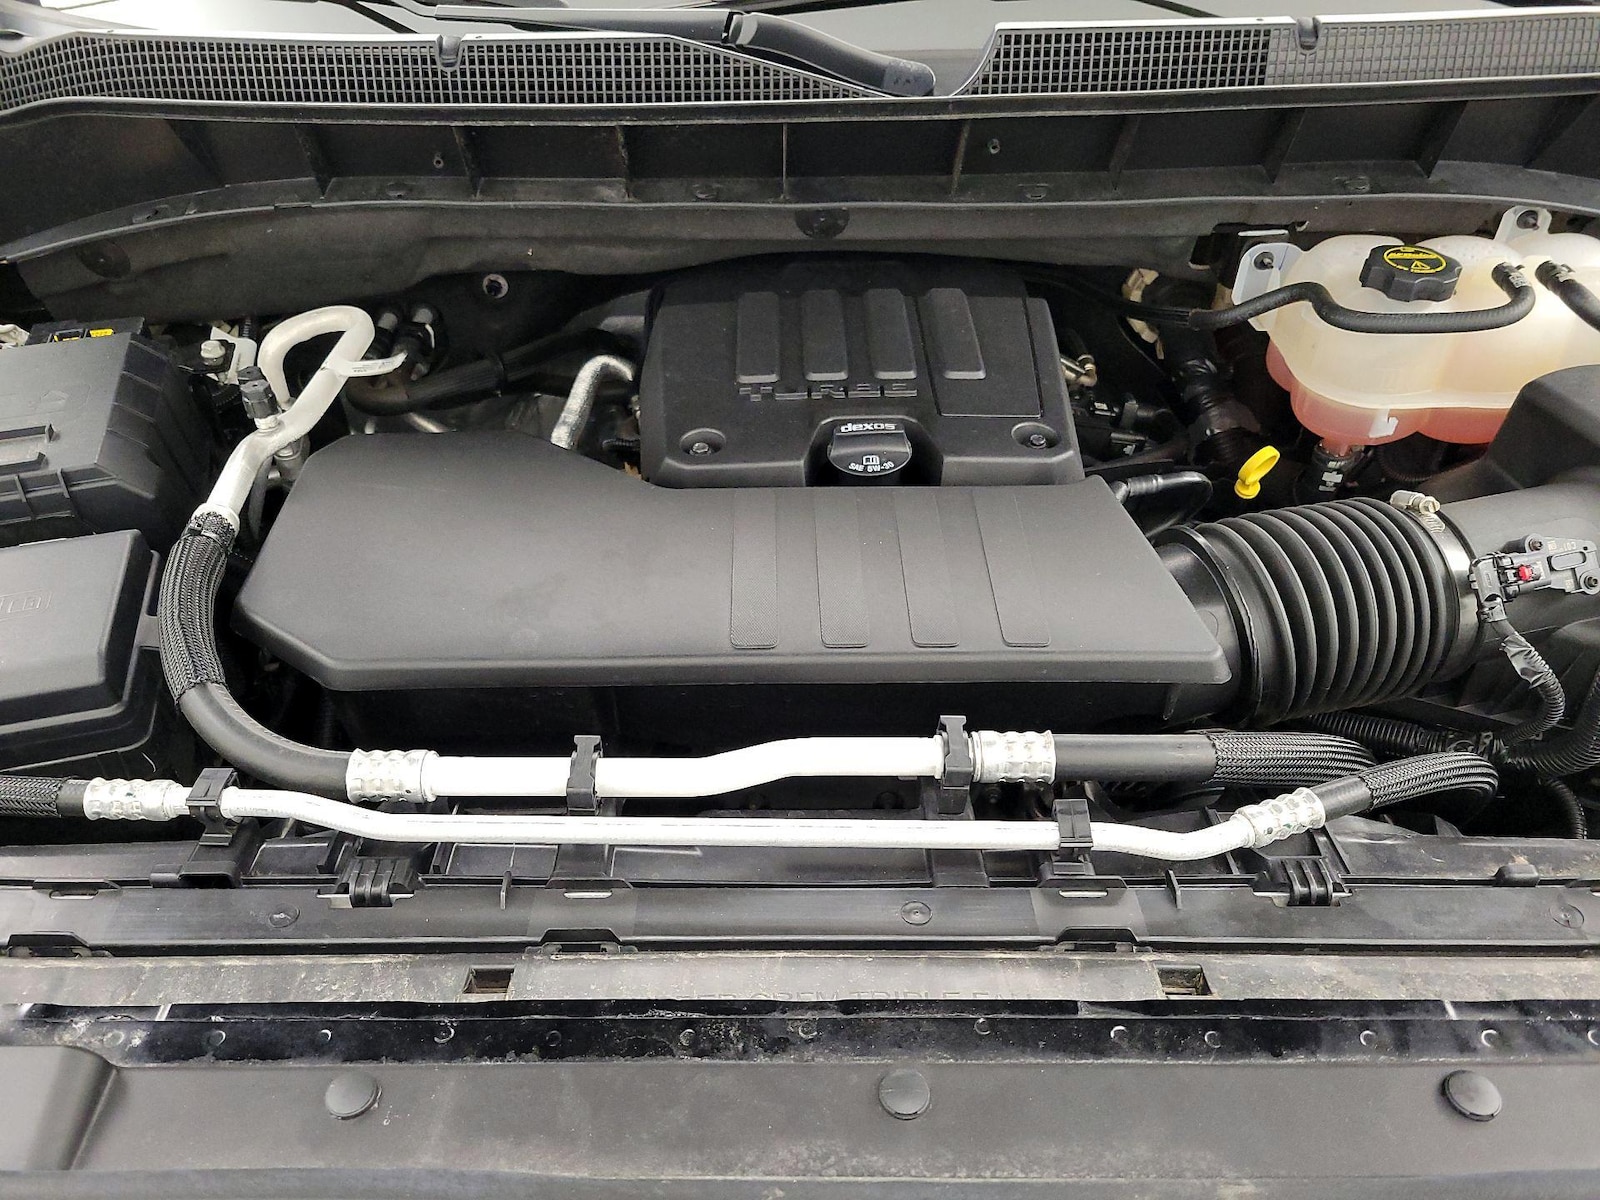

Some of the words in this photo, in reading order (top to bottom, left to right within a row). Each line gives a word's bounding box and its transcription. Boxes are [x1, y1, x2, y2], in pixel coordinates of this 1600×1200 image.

[840, 422, 897, 433] dexos
[848, 462, 864, 472] SAE
[867, 461, 895, 473] 5W-30
